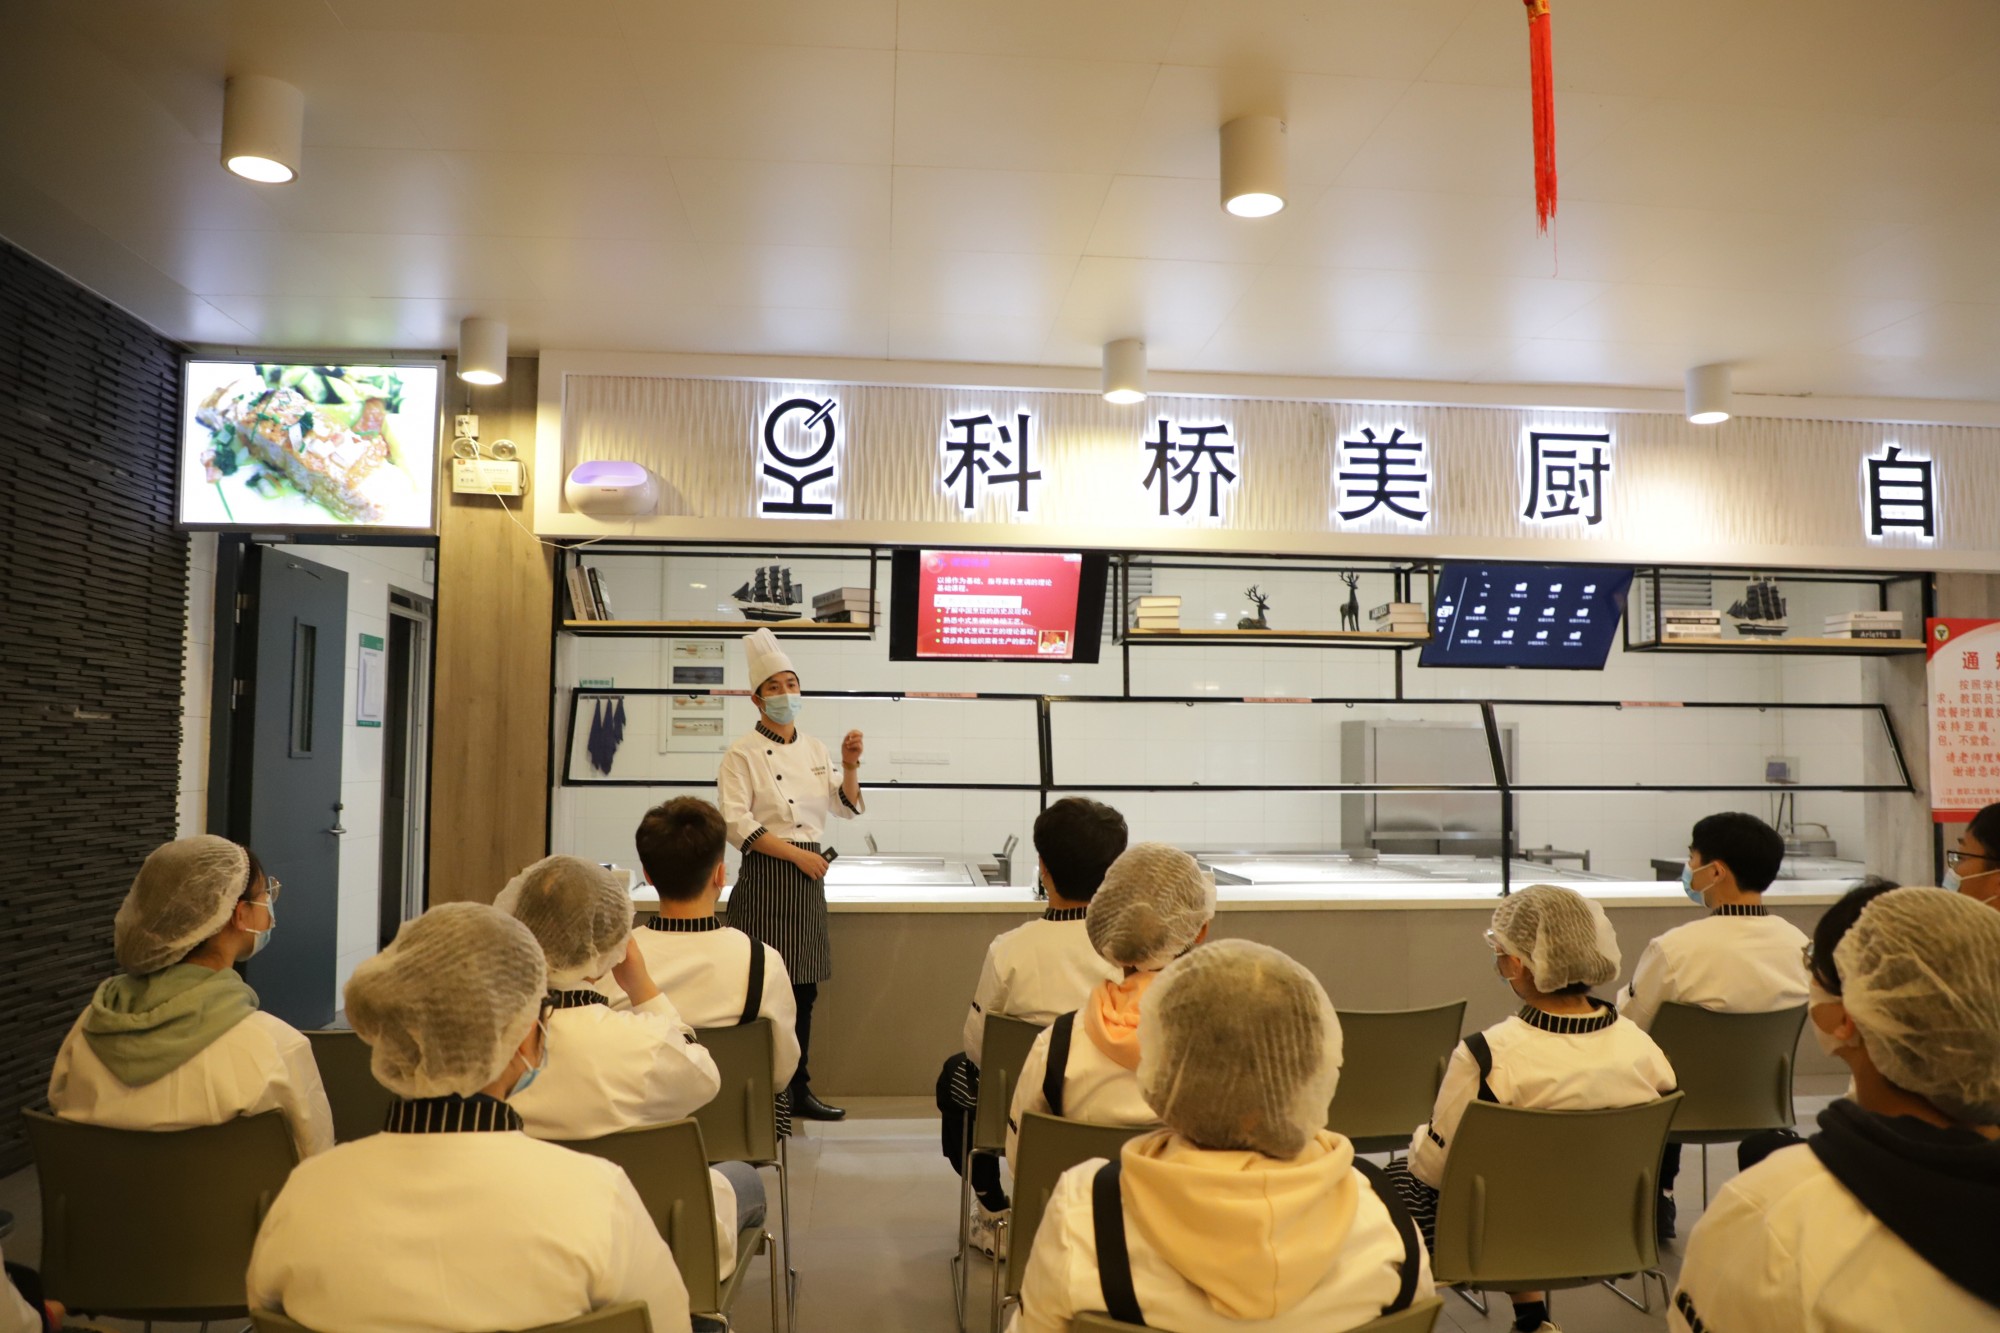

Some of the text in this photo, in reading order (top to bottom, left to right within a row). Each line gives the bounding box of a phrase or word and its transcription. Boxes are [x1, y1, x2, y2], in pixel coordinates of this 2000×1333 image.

[944, 413, 1934, 538] 科桥美厨 自
